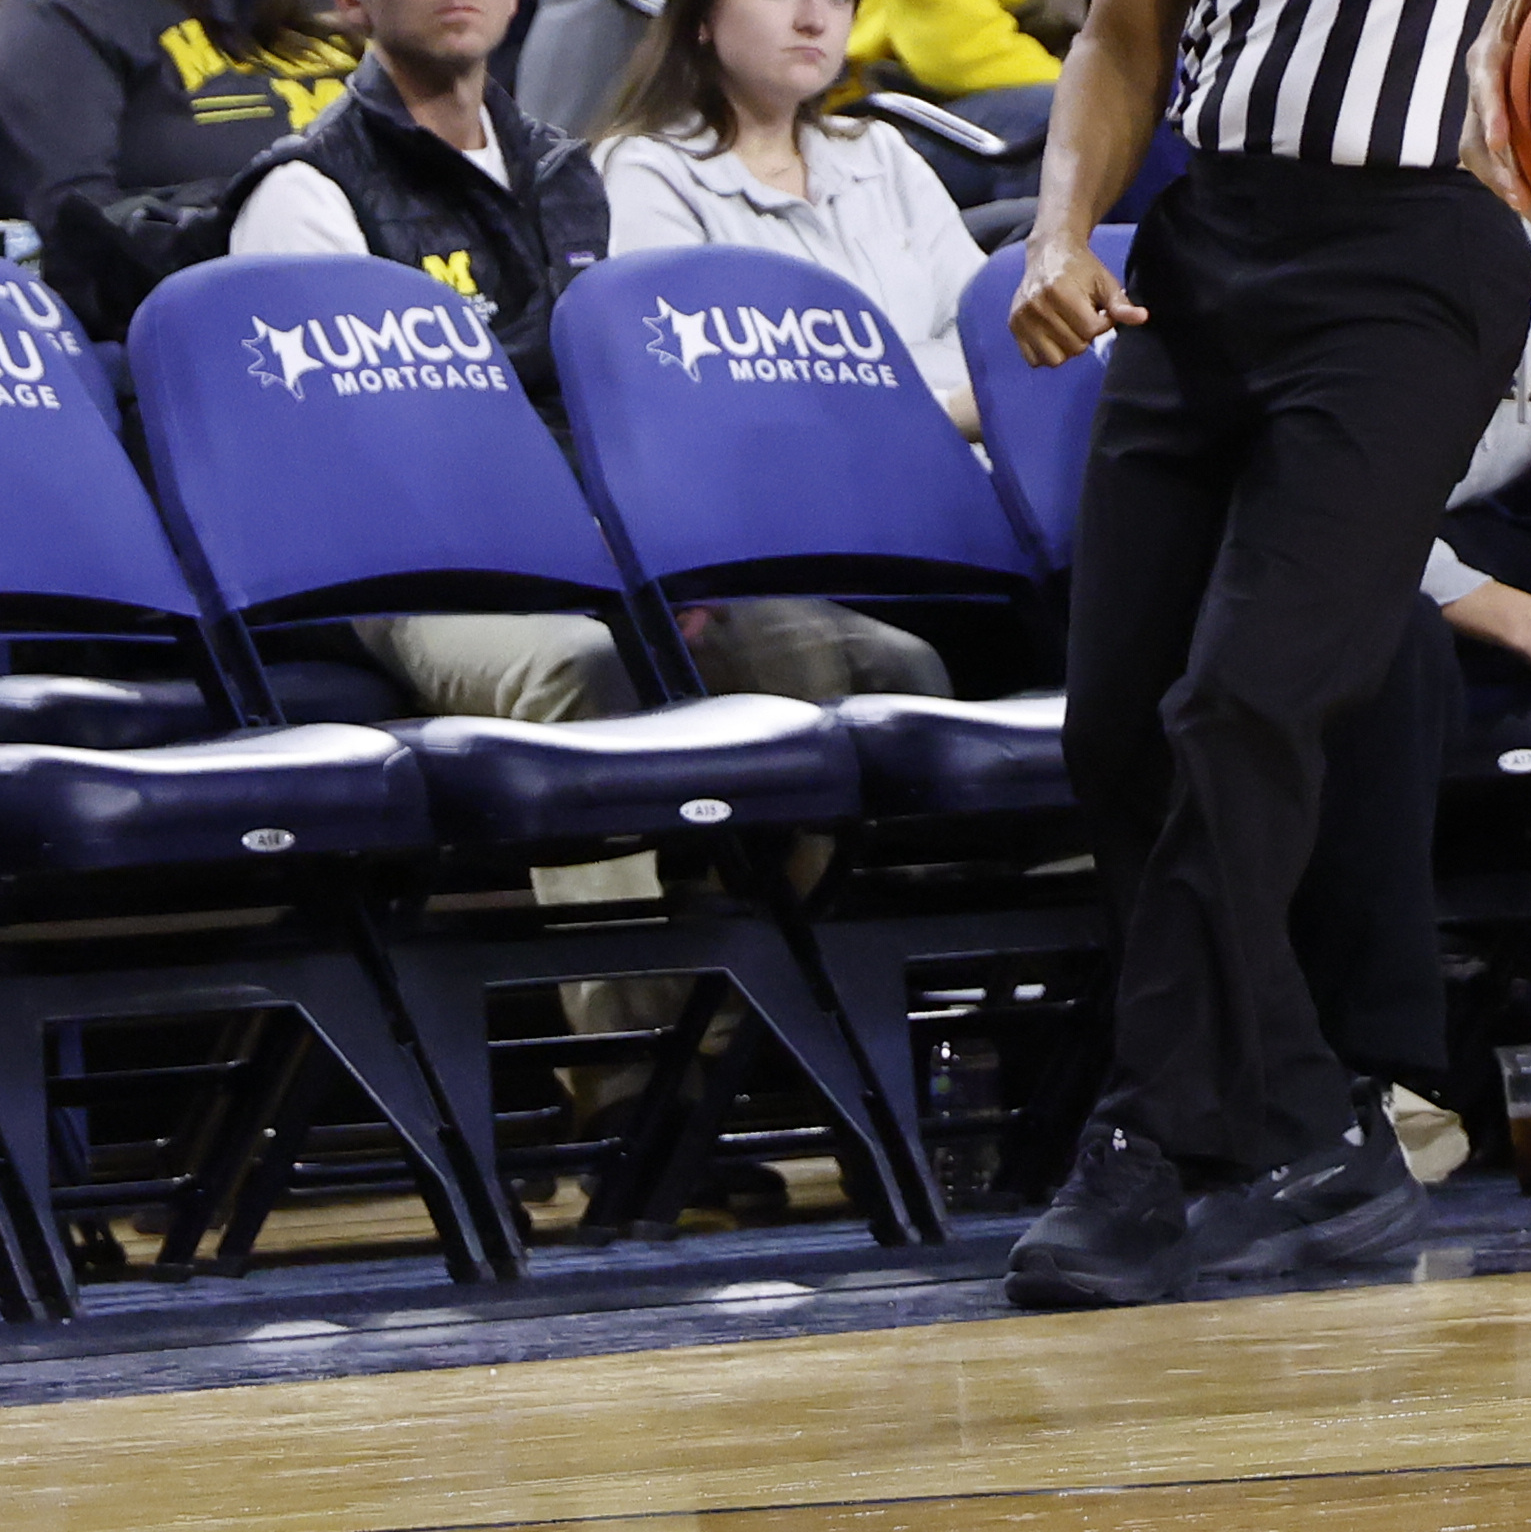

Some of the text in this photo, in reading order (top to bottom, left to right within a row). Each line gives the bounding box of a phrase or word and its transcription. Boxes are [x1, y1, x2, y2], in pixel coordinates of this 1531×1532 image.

[307, 304, 493, 370] UMCU
[710, 306, 886, 362] UMCU
[331, 363, 510, 397] MORTGAGE
[728, 358, 900, 388] MORTGAGE
